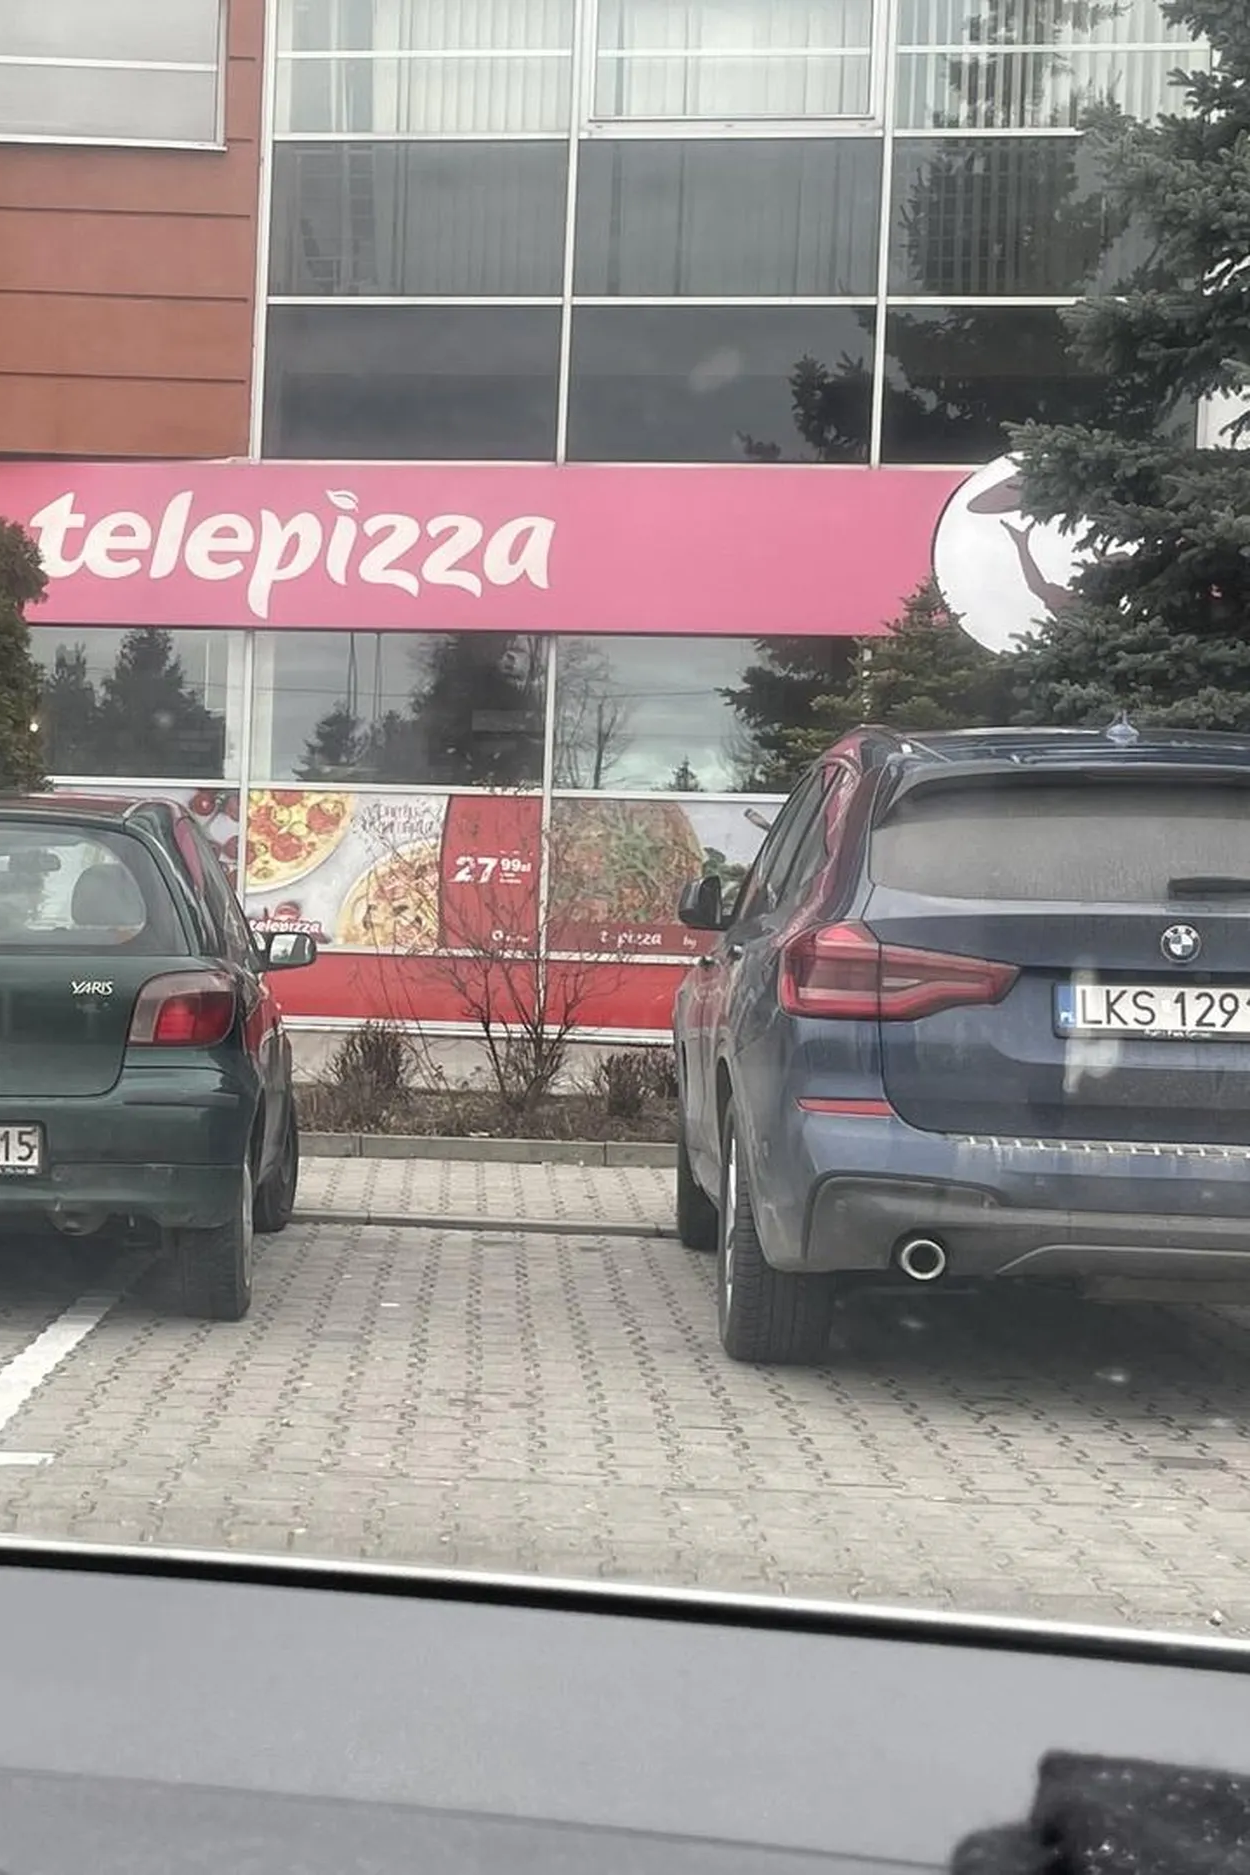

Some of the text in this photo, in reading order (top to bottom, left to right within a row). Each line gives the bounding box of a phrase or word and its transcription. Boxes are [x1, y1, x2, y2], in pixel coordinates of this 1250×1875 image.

[28, 489, 556, 619] telepizza
[450, 856, 499, 884] 27
[71, 980, 113, 996] YARIS
[1081, 988, 1250, 1028] LKS 129
